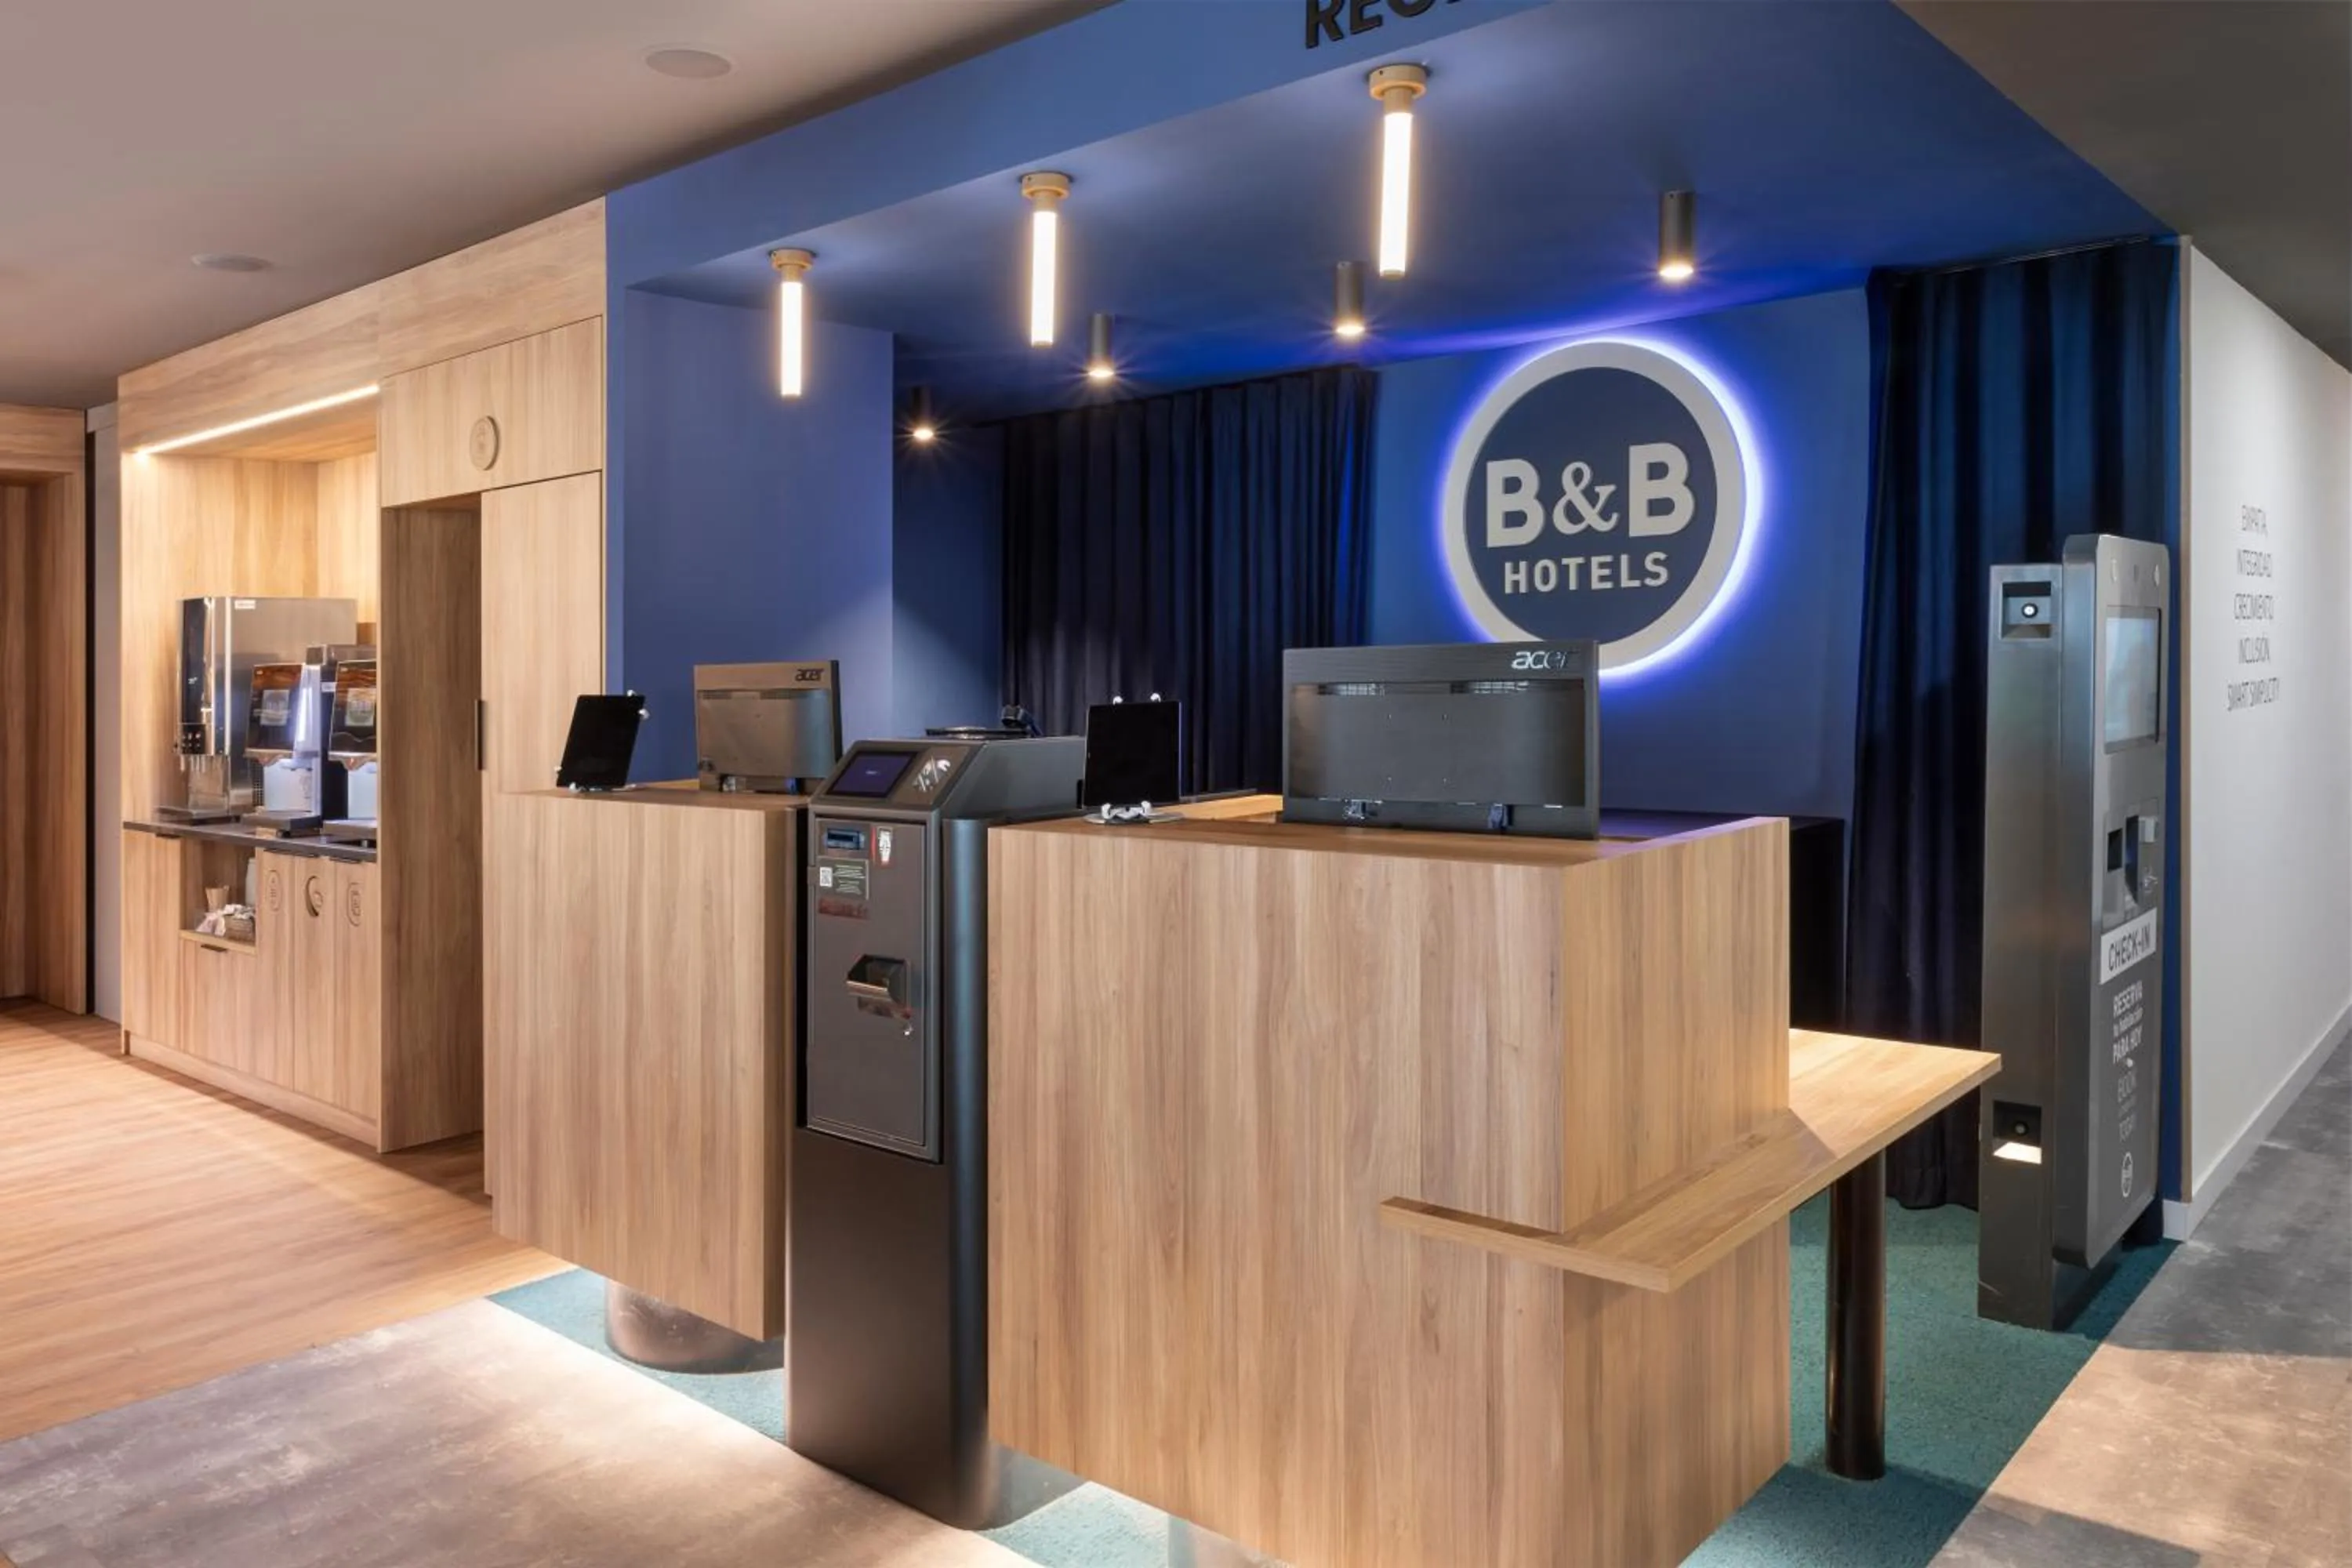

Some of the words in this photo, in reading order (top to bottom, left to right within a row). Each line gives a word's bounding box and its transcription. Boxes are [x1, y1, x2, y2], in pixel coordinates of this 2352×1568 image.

[1305, 0, 1461, 49] RE
[1486, 442, 1695, 548] B&B
[1504, 552, 1668, 594] HOTELS
[795, 668, 824, 681] acer
[2107, 928, 2151, 971] CHECK-IN
